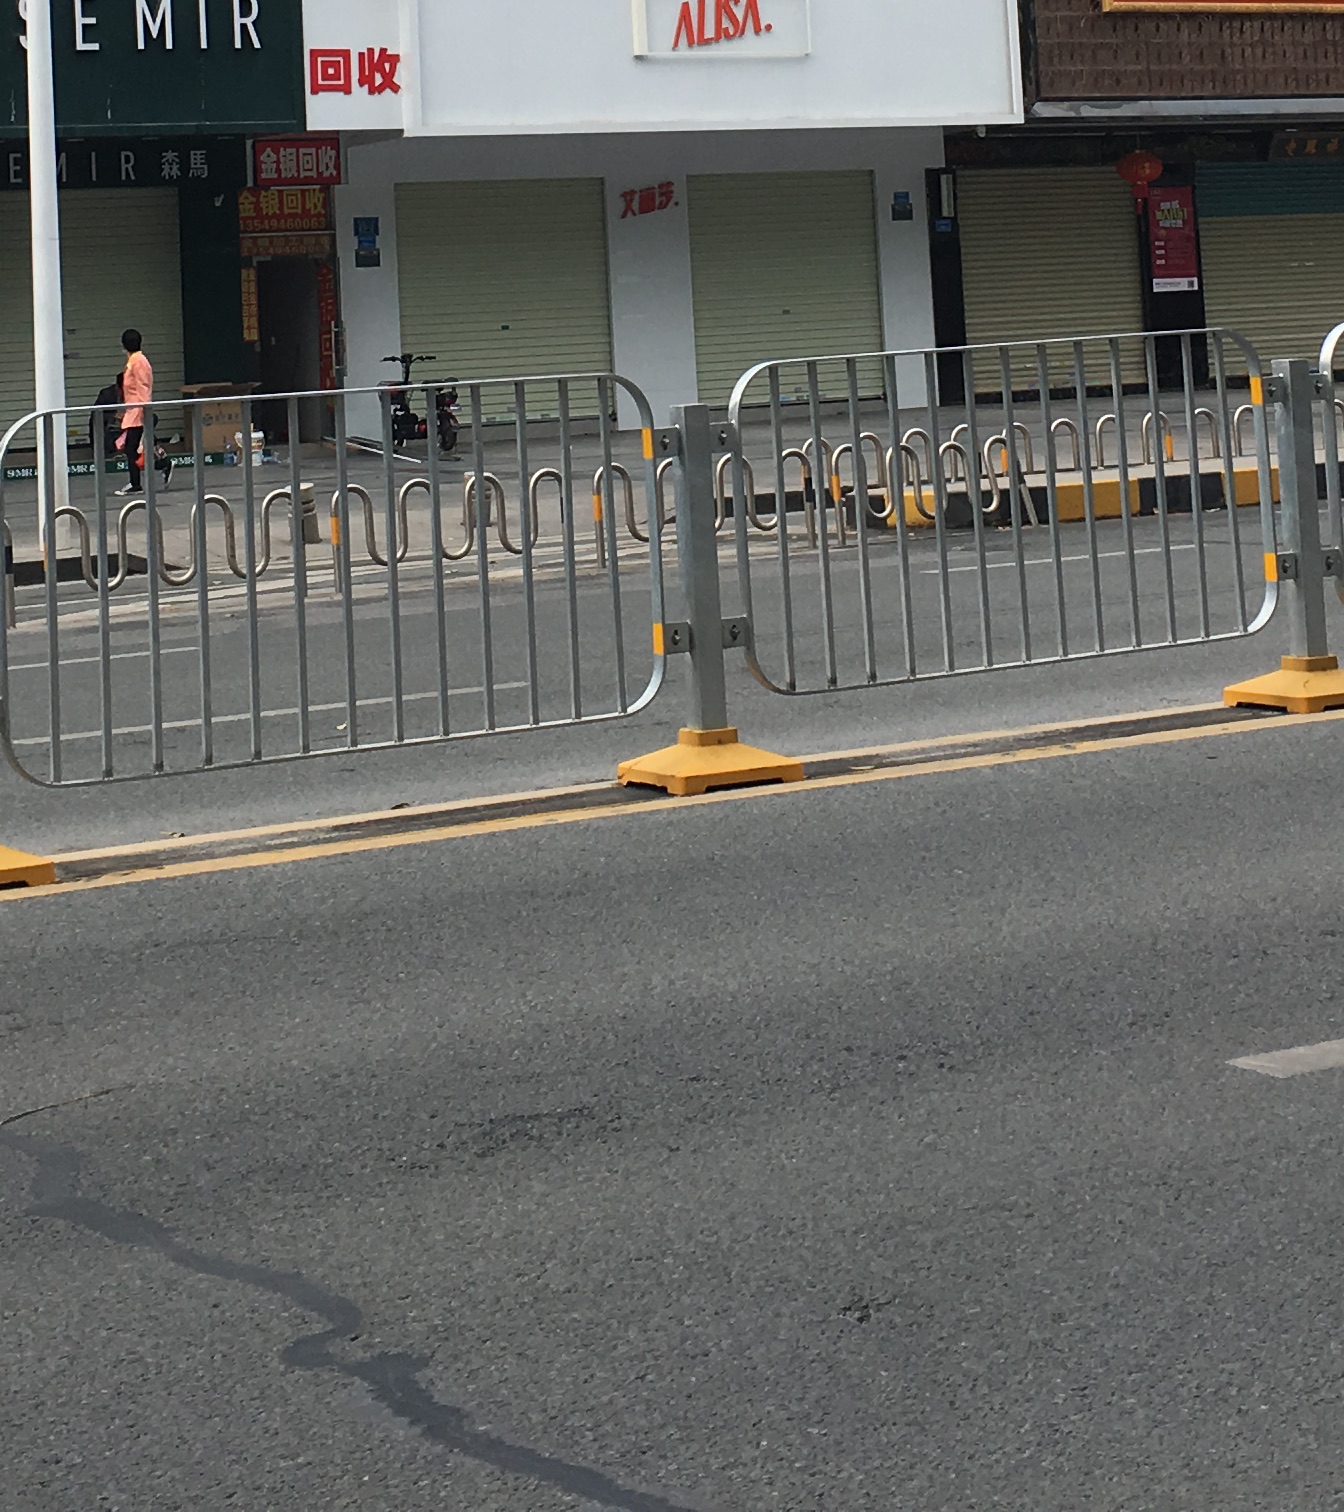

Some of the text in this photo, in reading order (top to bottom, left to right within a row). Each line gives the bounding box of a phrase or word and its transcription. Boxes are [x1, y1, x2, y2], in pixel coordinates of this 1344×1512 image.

[309, 47, 401, 95] 回收
[160, 149, 209, 180] 森馬
[260, 146, 337, 179] 金银回收
[239, 188, 326, 217] 金银回收
